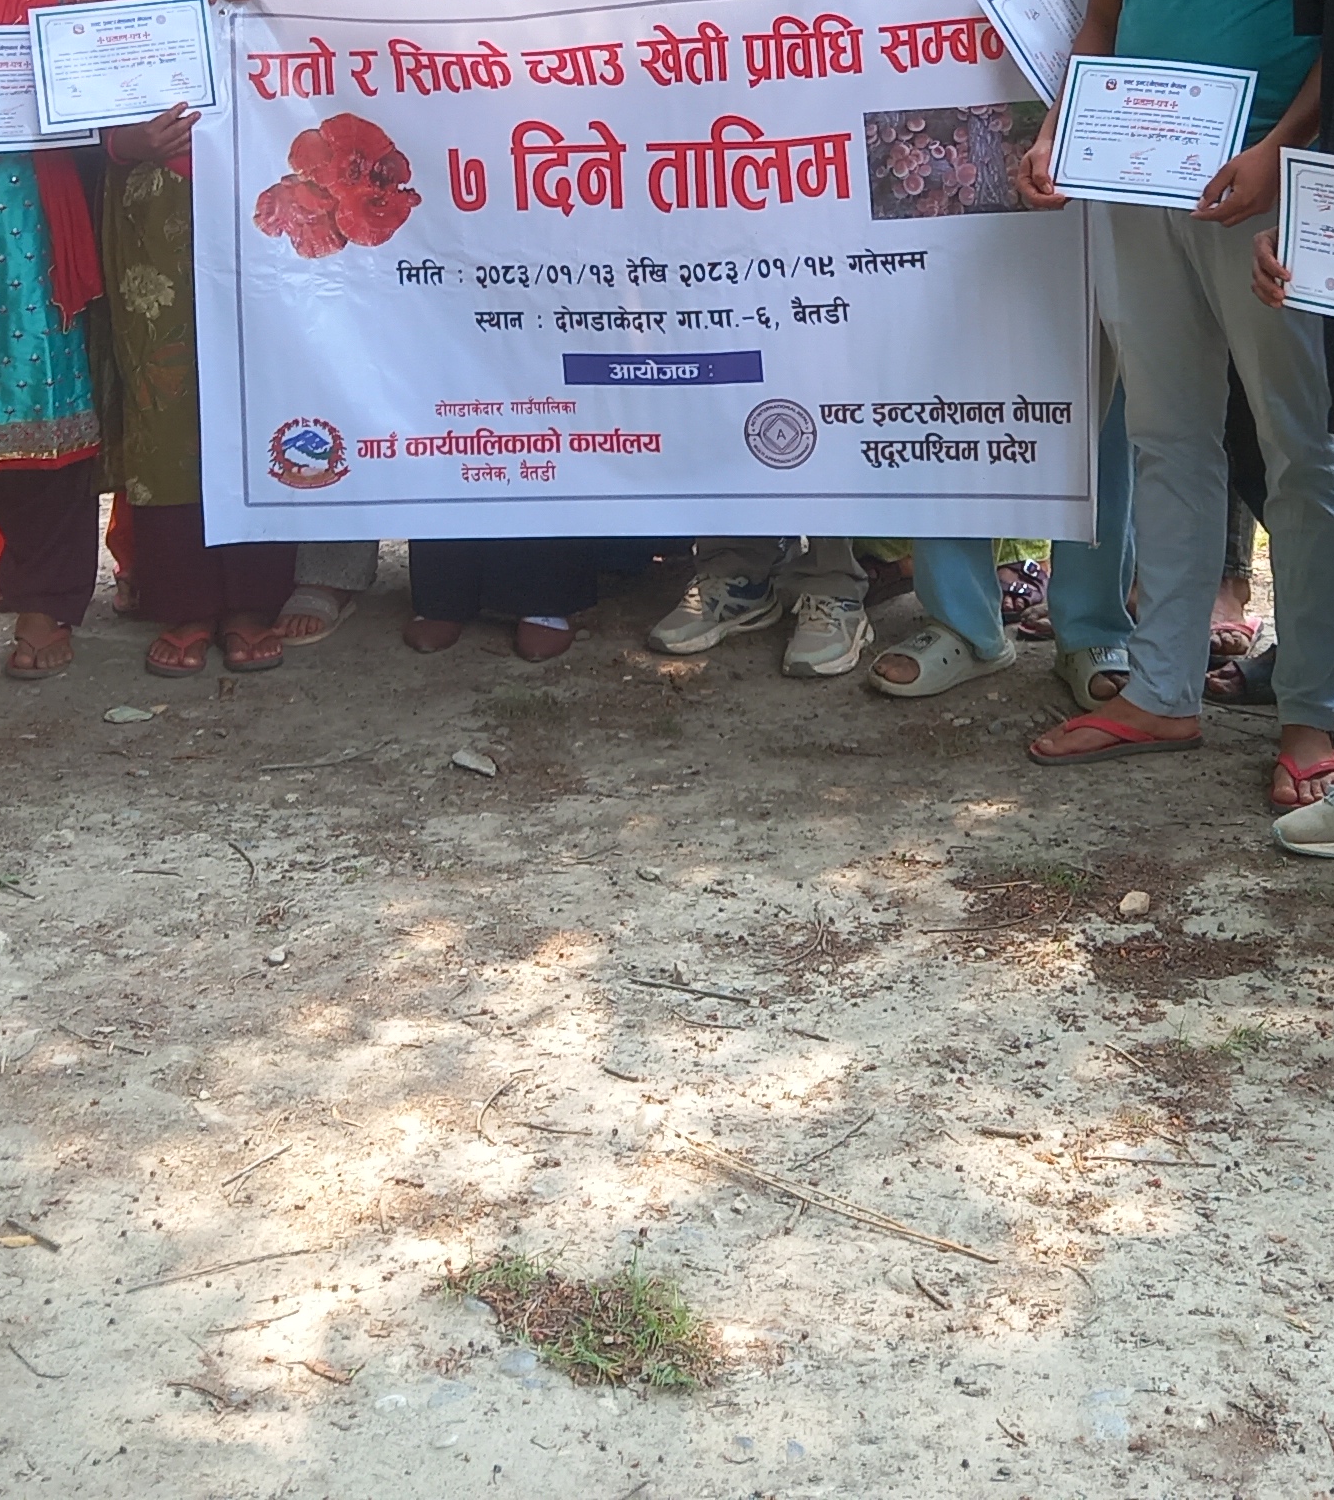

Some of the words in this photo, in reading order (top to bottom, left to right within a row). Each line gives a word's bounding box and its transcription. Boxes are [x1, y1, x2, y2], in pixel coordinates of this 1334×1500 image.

[247, 37, 336, 100] रातो
[349, 51, 378, 98] र
[388, 38, 512, 96] सितके
[521, 43, 625, 86] च्याउ
[636, 21, 729, 86] खेती
[742, 13, 863, 88] प्रविधि
[448, 148, 487, 211] ७
[510, 120, 627, 217] दिने
[646, 115, 852, 214] तालिम
[396, 259, 445, 287] मिति
[475, 264, 615, 289] २०८३/०१/१३
[626, 257, 668, 287] देखि
[678, 255, 835, 287] २०८३/०१/१९
[846, 248, 928, 276] गतेसम्म
[474, 311, 524, 333] स्थान
[553, 305, 667, 334] दोगडाकेदार
[676, 306, 780, 331] गा.पा.-६,
[790, 296, 850, 325] बैतडी
[609, 359, 700, 380] आयोजक
[435, 398, 504, 417] दोगडाकेदार
[510, 396, 577, 415] गाउँपालिका
[819, 403, 865, 424] एक्ट
[871, 394, 1005, 427] इन्टरनेशनल
[1012, 394, 1072, 425] नेपाल
[357, 431, 398, 459] गाउँ
[405, 427, 563, 457] कार्यपालिकाको
[568, 428, 662, 455] कार्यालय
[777, 429, 787, 441] A
[860, 433, 980, 468] सुदूरपश्चिम
[987, 433, 1037, 465] प्रदेश
[461, 463, 511, 485] देउलेक,
[520, 460, 556, 481] बैतडी
